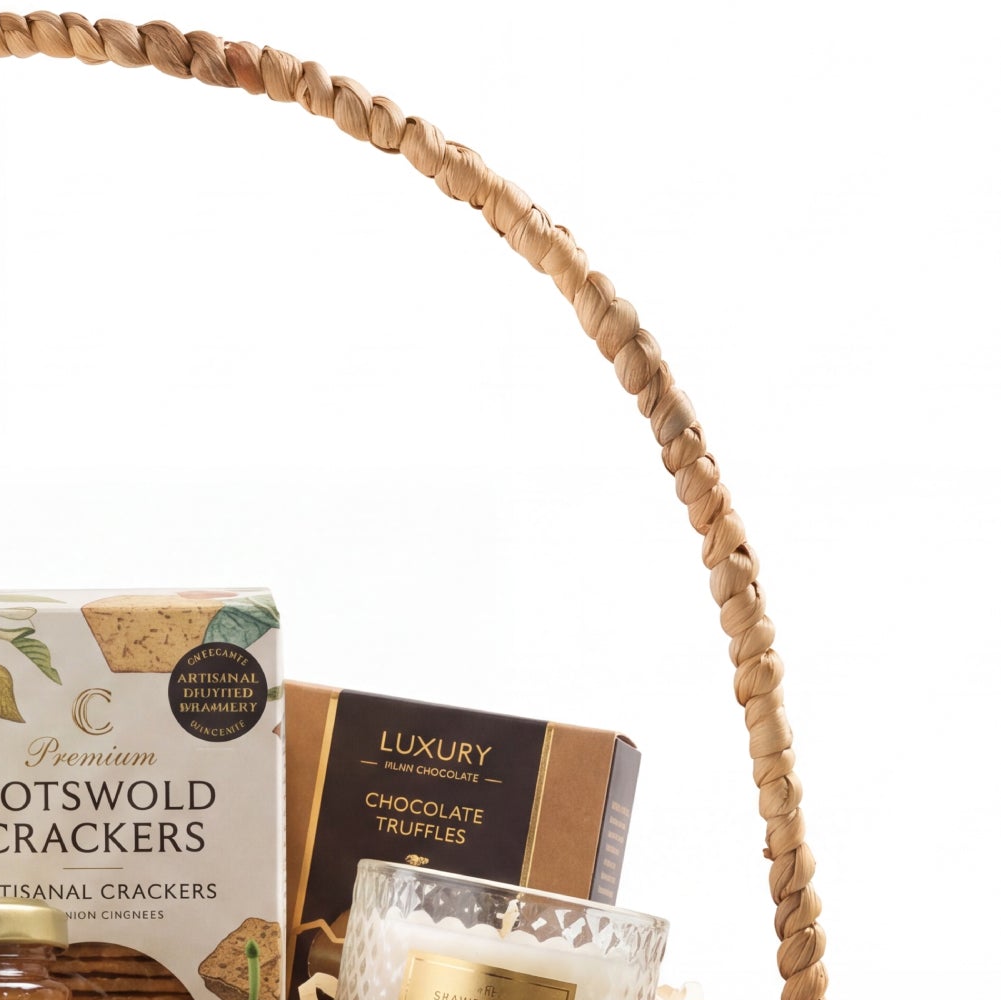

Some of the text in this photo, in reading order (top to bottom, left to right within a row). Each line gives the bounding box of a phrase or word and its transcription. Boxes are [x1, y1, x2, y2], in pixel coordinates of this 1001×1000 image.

[24, 736, 158, 768] Premium
[380, 731, 492, 766] LUXURY
[416, 765, 480, 783] CHOCOLATE
[365, 792, 485, 825] CHOCOLATE
[376, 816, 467, 845] TRUFFLES
[100, 883, 217, 900] CRACKERS
[101, 910, 165, 920] CINGNEES
